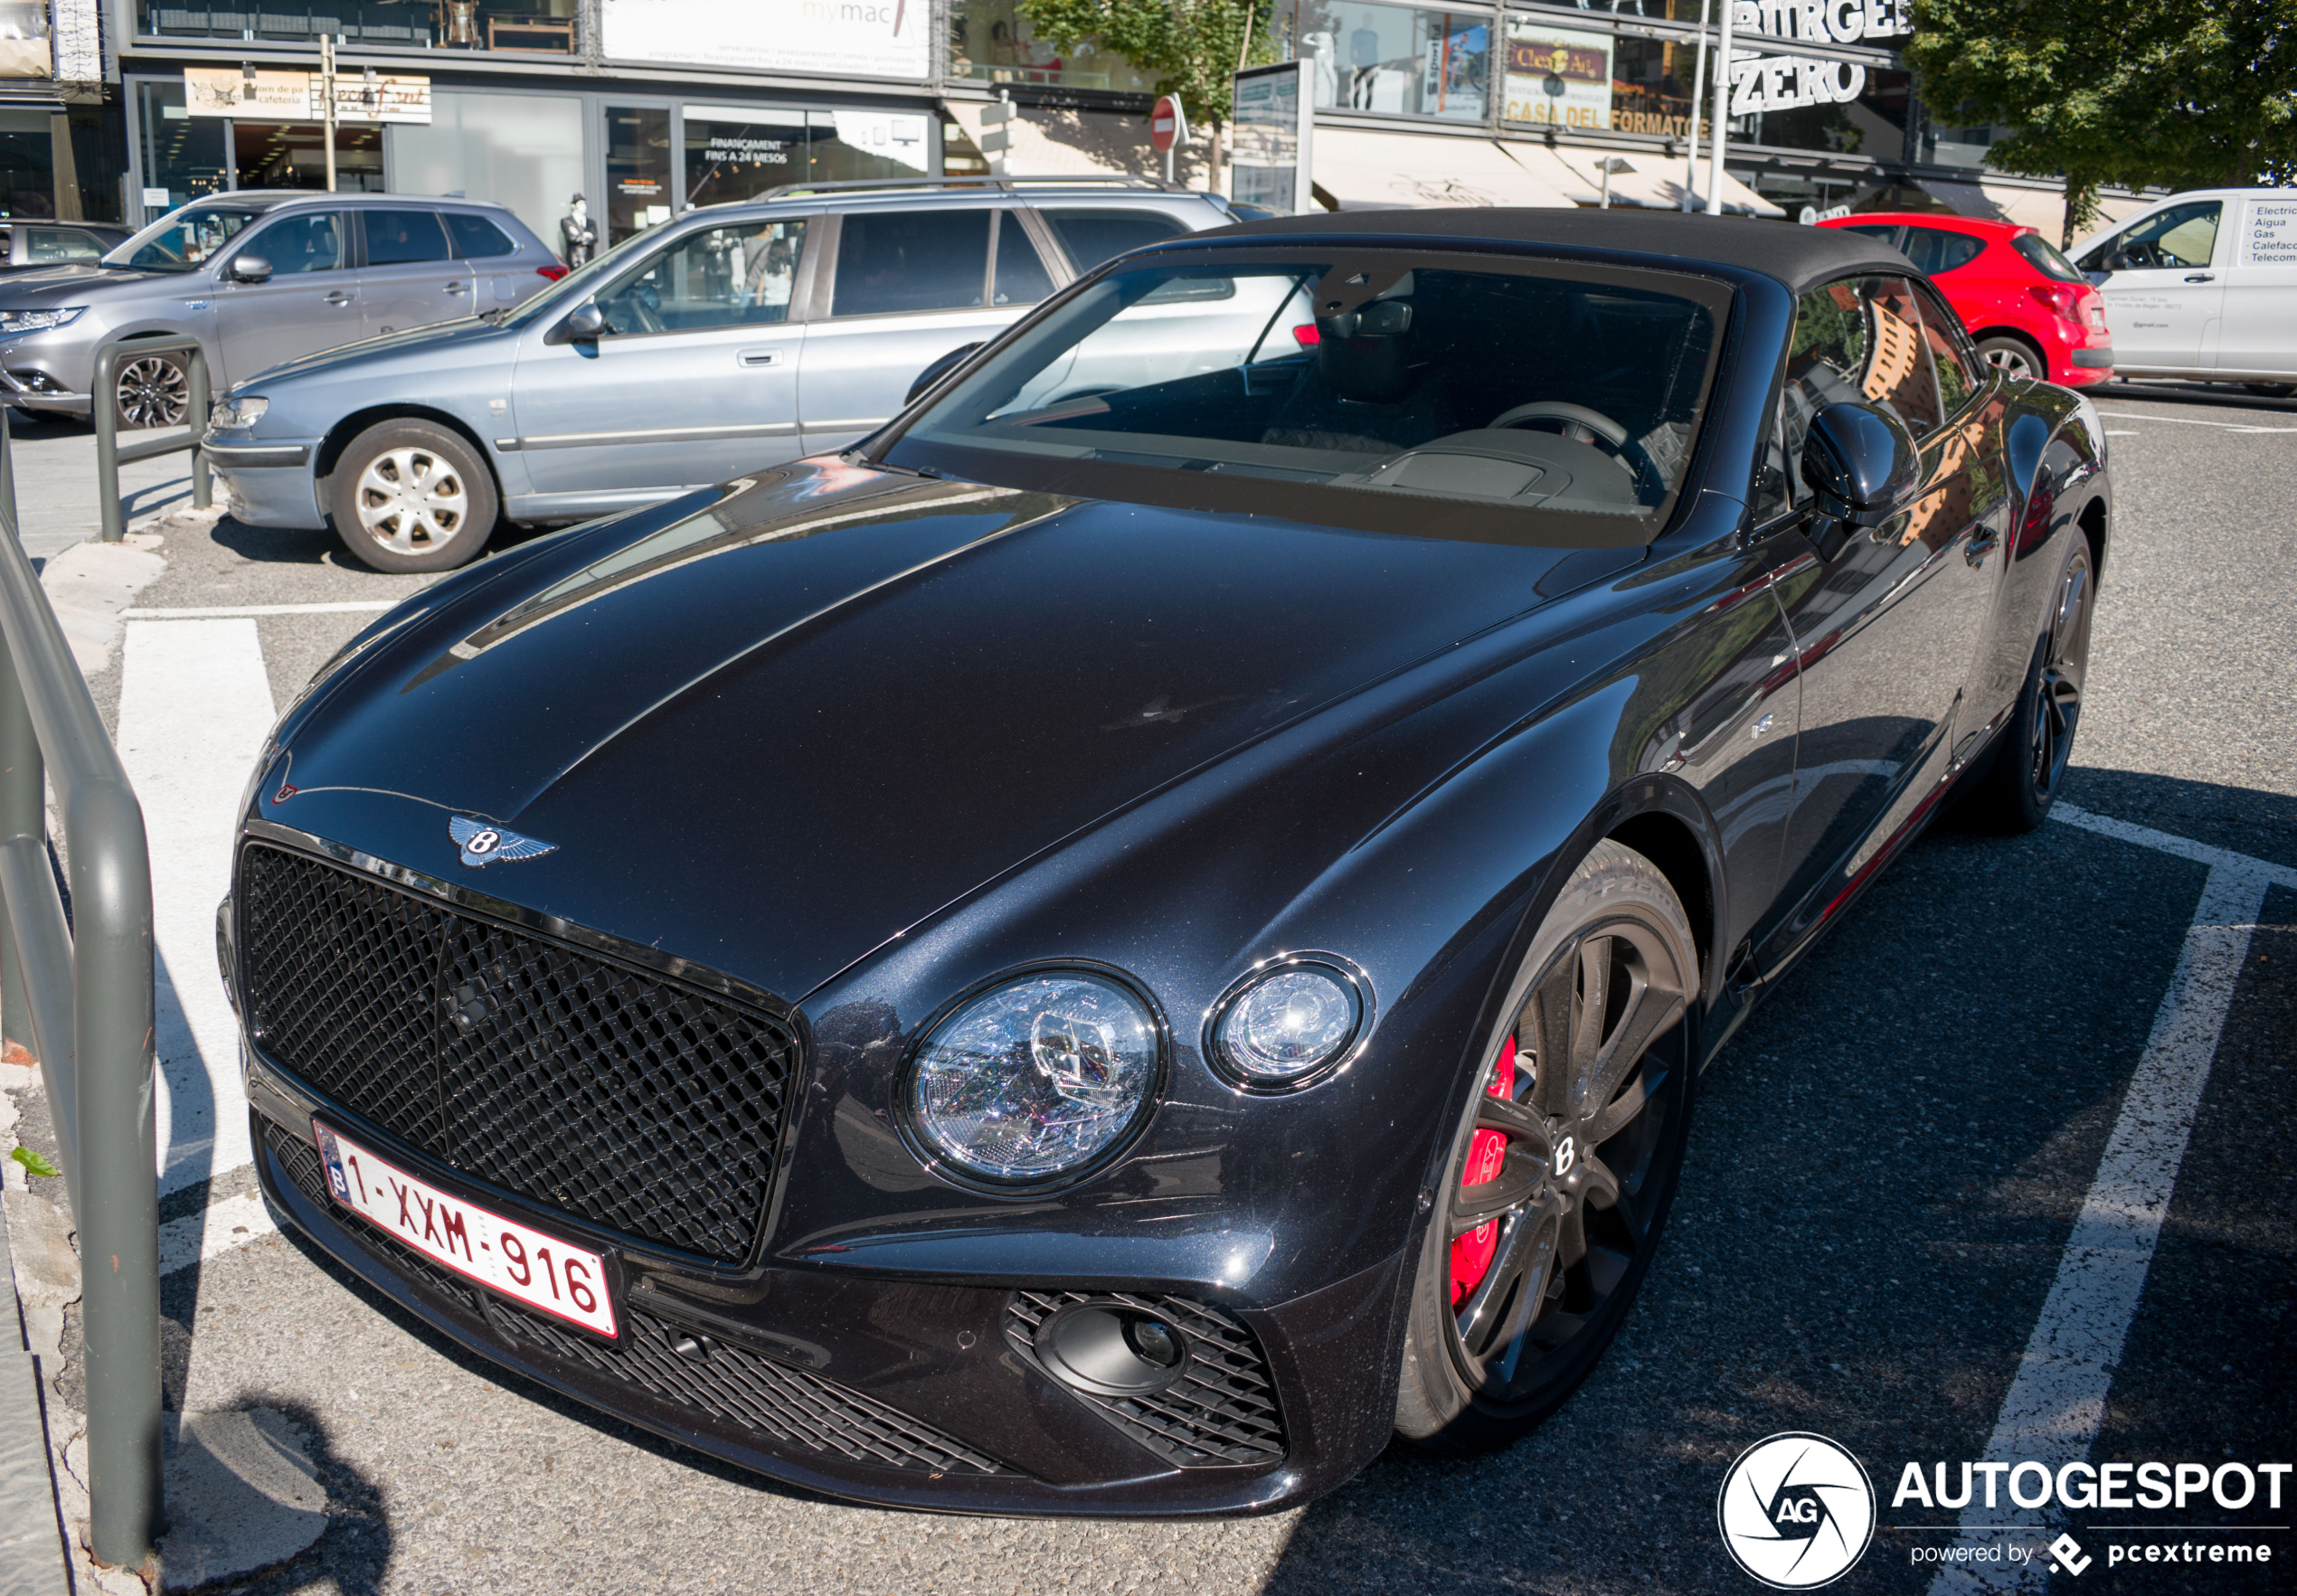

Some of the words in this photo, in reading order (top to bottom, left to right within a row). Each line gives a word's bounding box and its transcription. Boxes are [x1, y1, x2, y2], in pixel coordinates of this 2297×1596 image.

[802, 1, 891, 25] mymac
[278, 85, 290, 93] de
[291, 86, 304, 95] pa
[1730, 55, 1867, 117] ZERO
[259, 94, 301, 105] cafeteria
[1507, 101, 1558, 125] CASA
[1565, 107, 1602, 129] DEL
[710, 137, 782, 152] FINANÇAMENT
[704, 150, 727, 162] FINS
[728, 151, 738, 162] A
[738, 151, 751, 163] 24
[752, 152, 788, 165] MESOS
[2254, 218, 2286, 229] Aigua
[2254, 230, 2275, 238] Gas
[329, 1165, 347, 1193] B
[347, 1154, 598, 1314] 1-XXM-916
